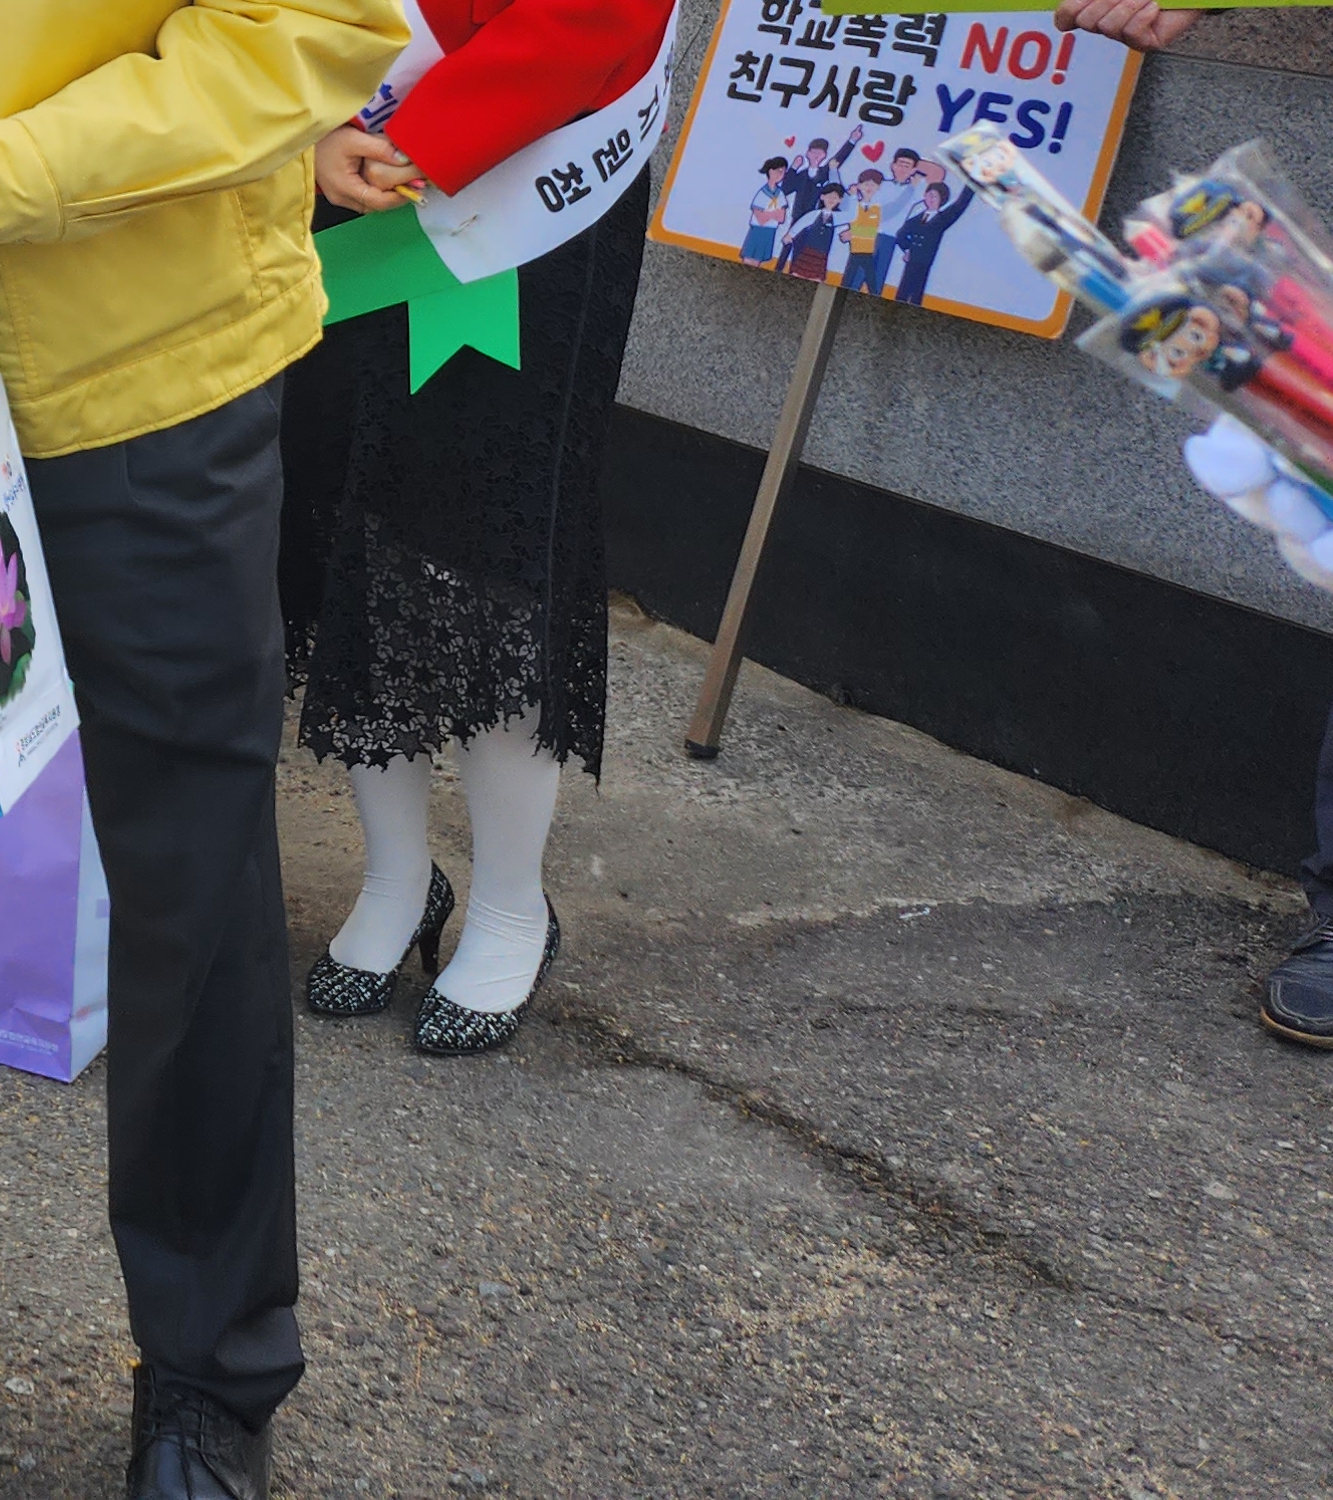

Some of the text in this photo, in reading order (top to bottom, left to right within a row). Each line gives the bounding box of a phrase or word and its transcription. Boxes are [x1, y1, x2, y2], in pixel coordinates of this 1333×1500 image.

[959, 22, 1076, 86] NO!
[726, 51, 1073, 154] 친구사랑 YES!
